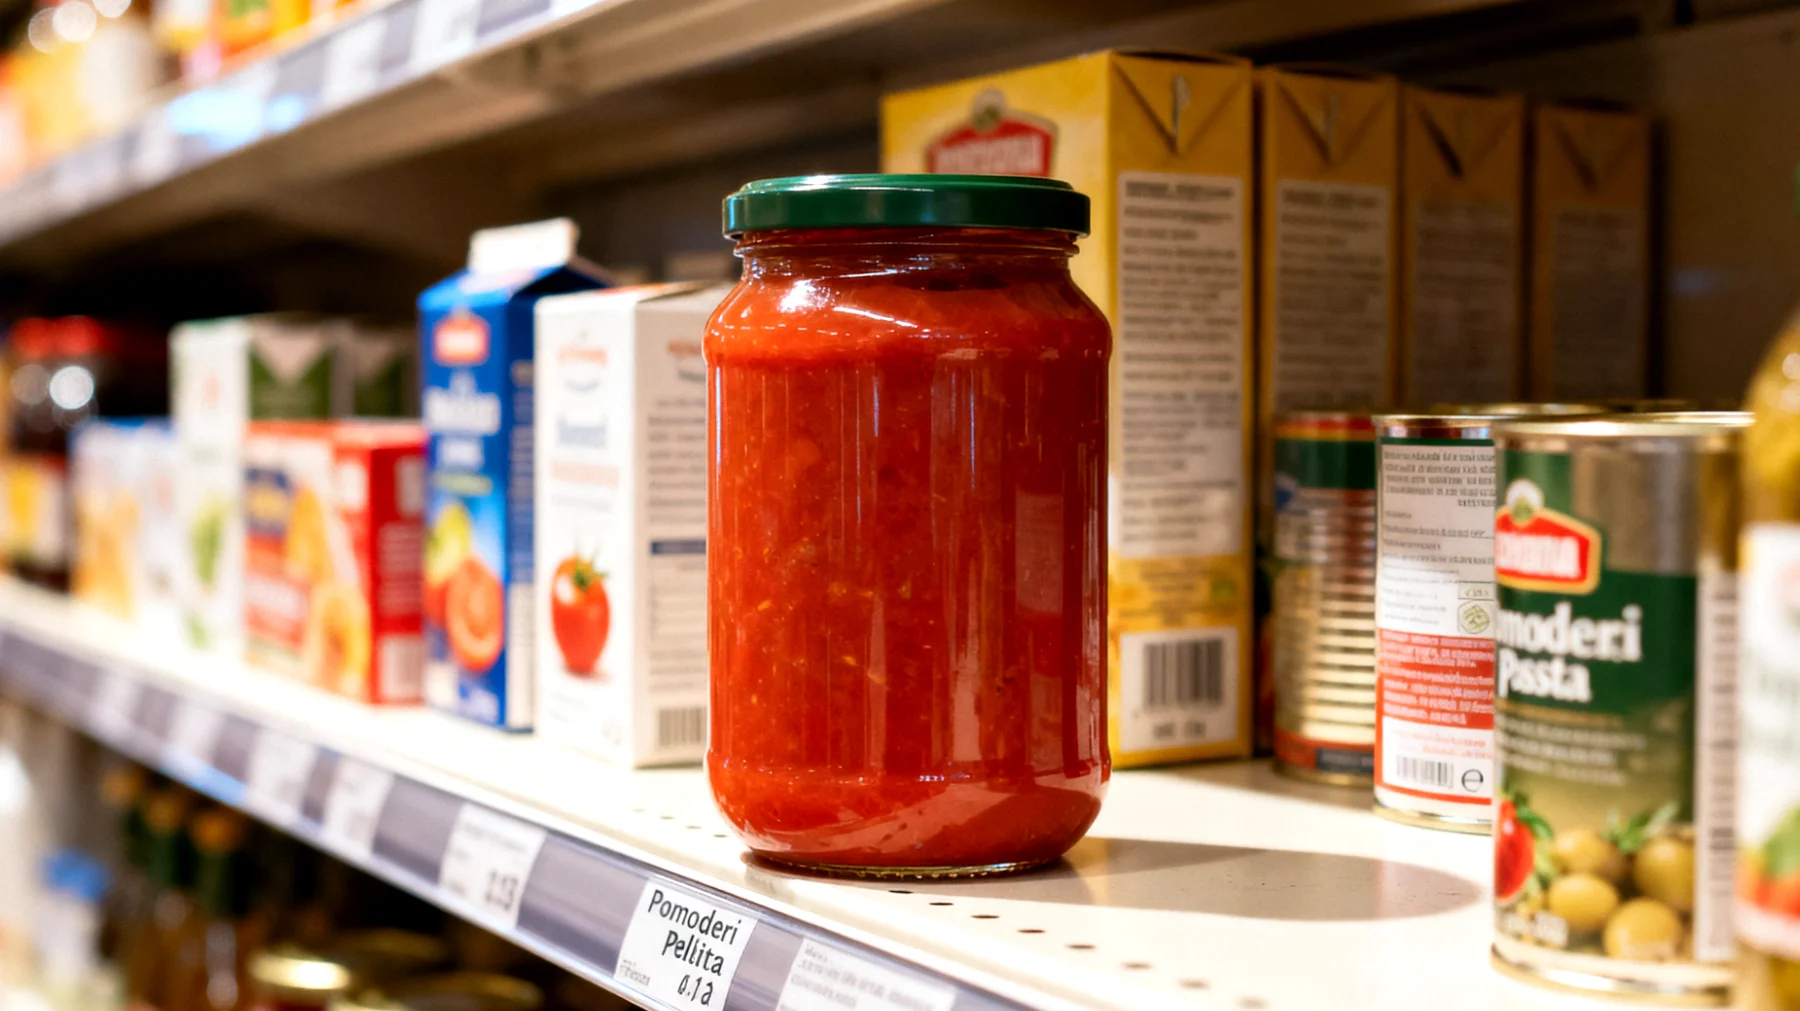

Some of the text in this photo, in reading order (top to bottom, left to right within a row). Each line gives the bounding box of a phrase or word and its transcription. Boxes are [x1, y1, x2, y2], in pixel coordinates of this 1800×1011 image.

[1497, 601, 1643, 662] moderi
[648, 888, 742, 945] Pomoderi
[661, 930, 725, 977] Pellita
